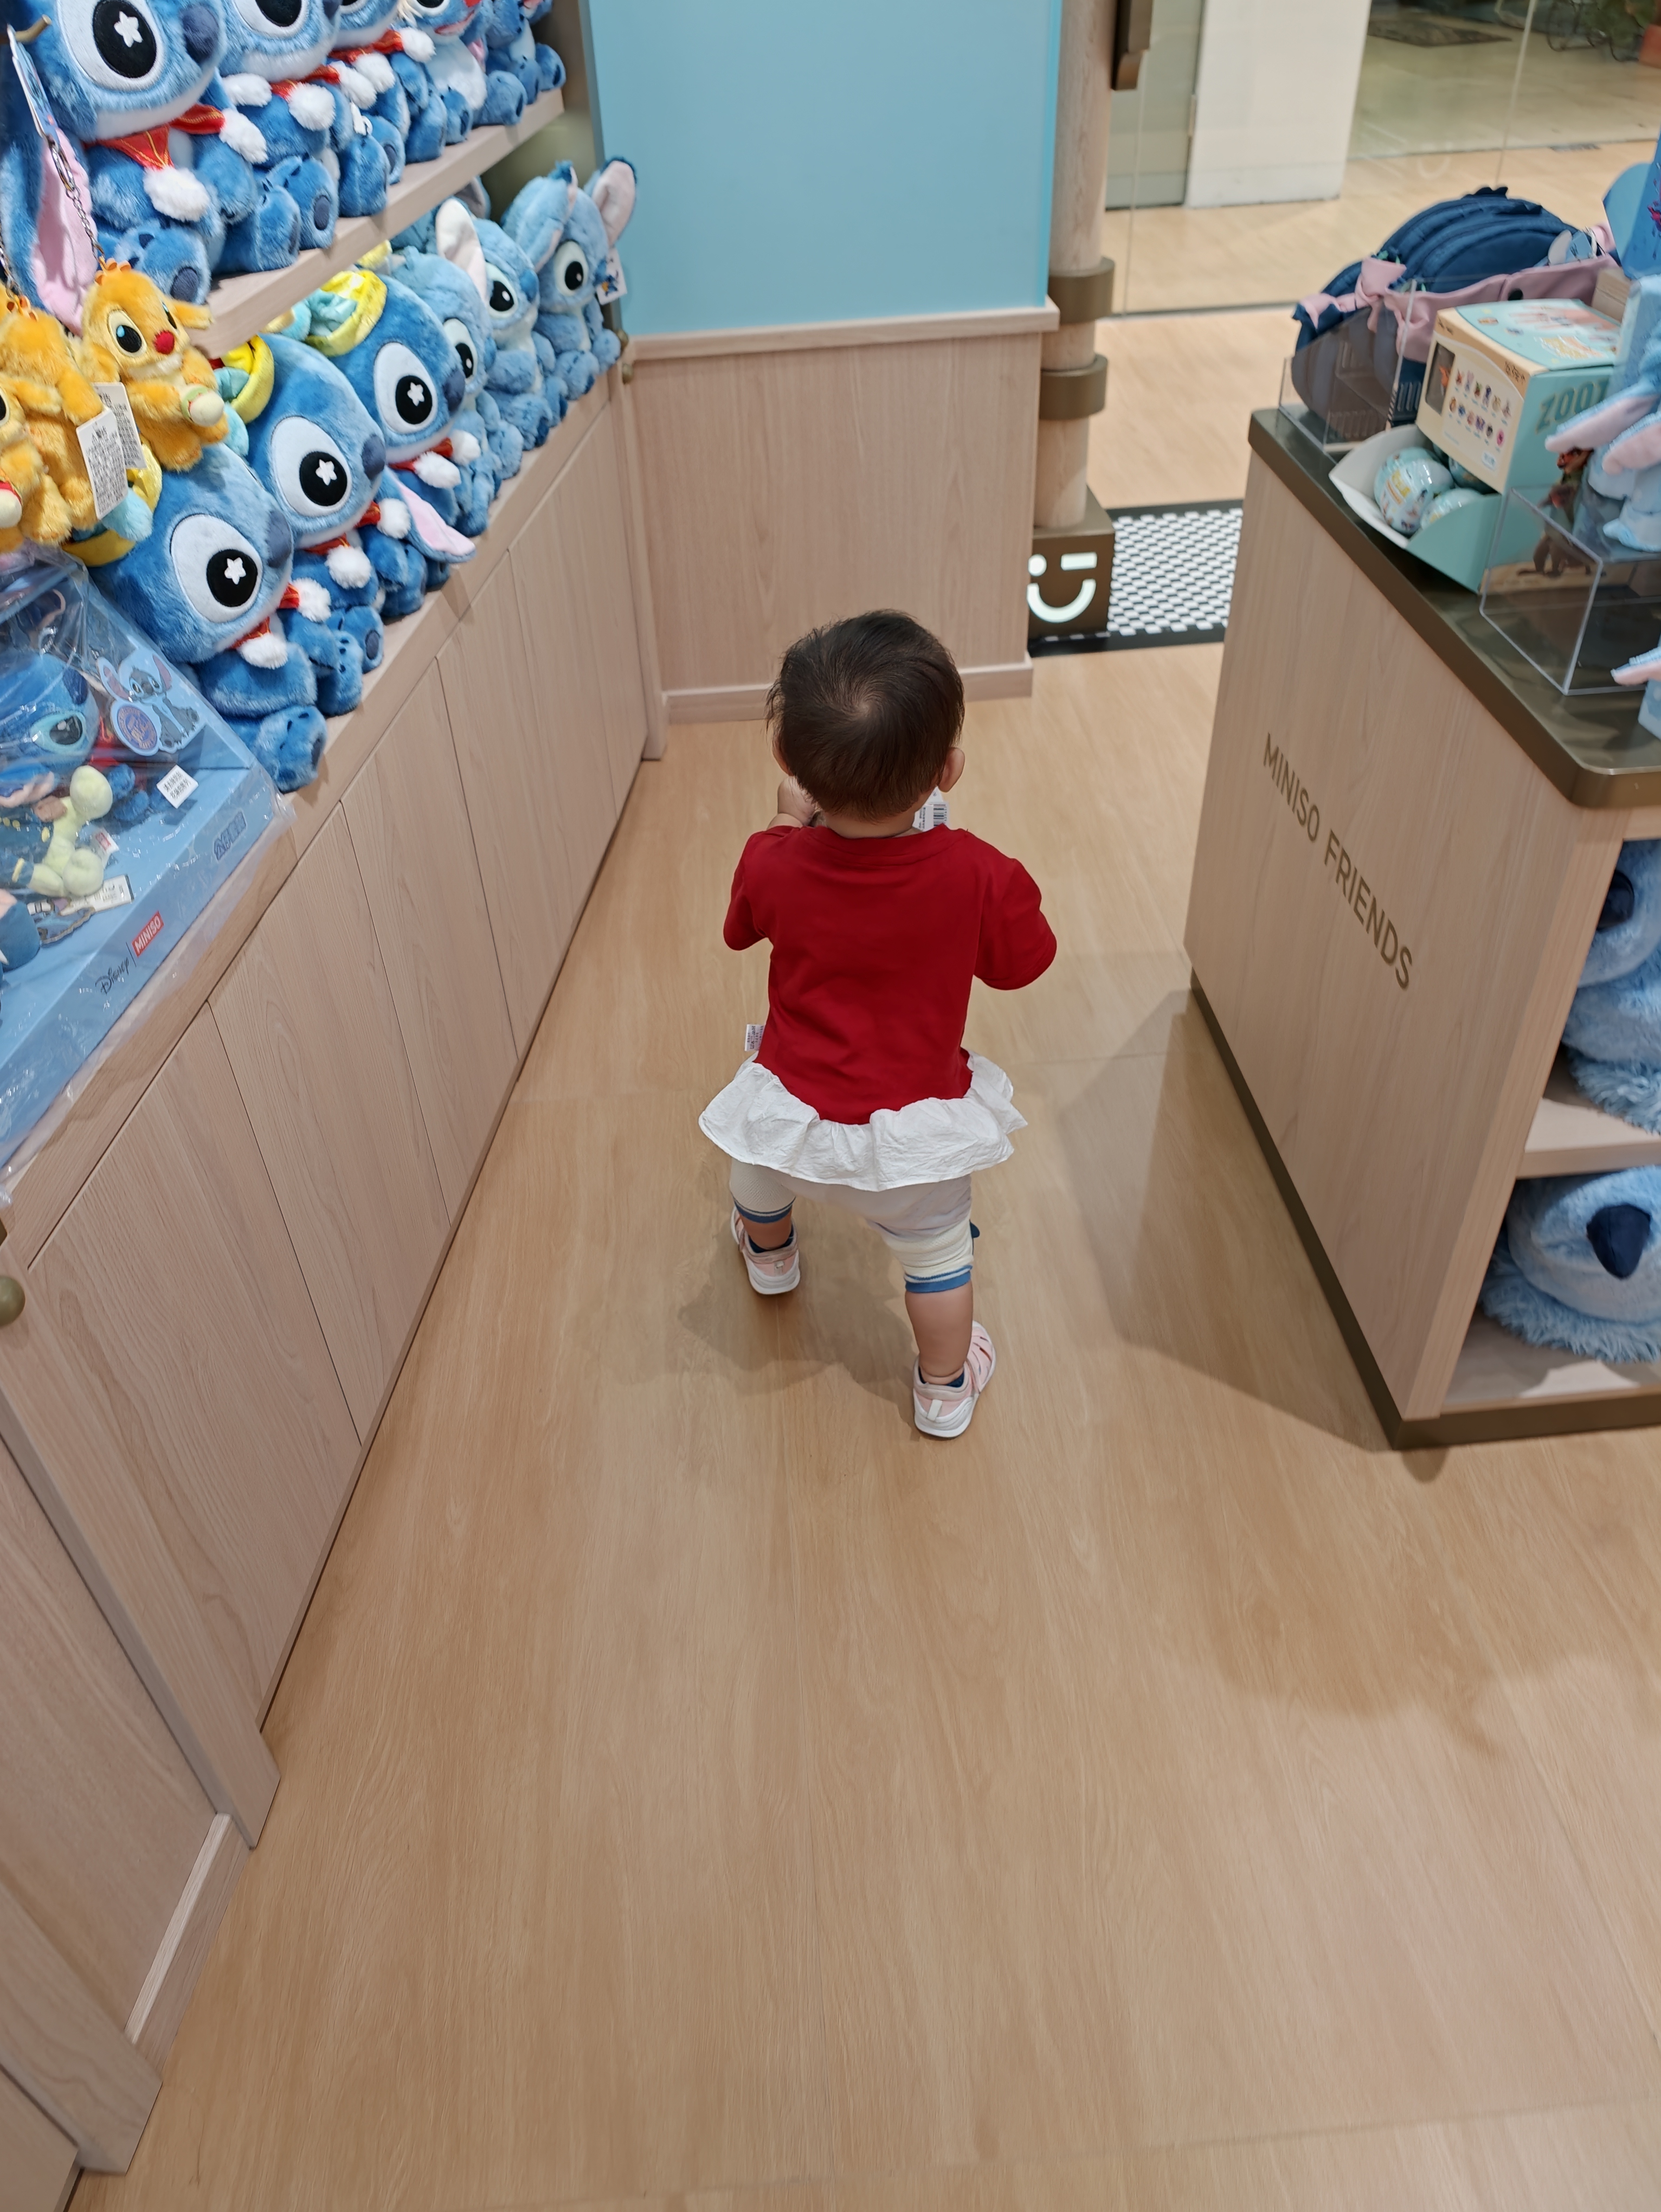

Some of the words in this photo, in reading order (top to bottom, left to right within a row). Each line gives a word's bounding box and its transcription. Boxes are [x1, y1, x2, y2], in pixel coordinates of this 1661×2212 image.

[1263, 732, 1320, 843] MINISO
[1324, 828, 1413, 991] FRIENDS
[95, 956, 130, 995] Disney
[134, 915, 161, 955] MINISO
